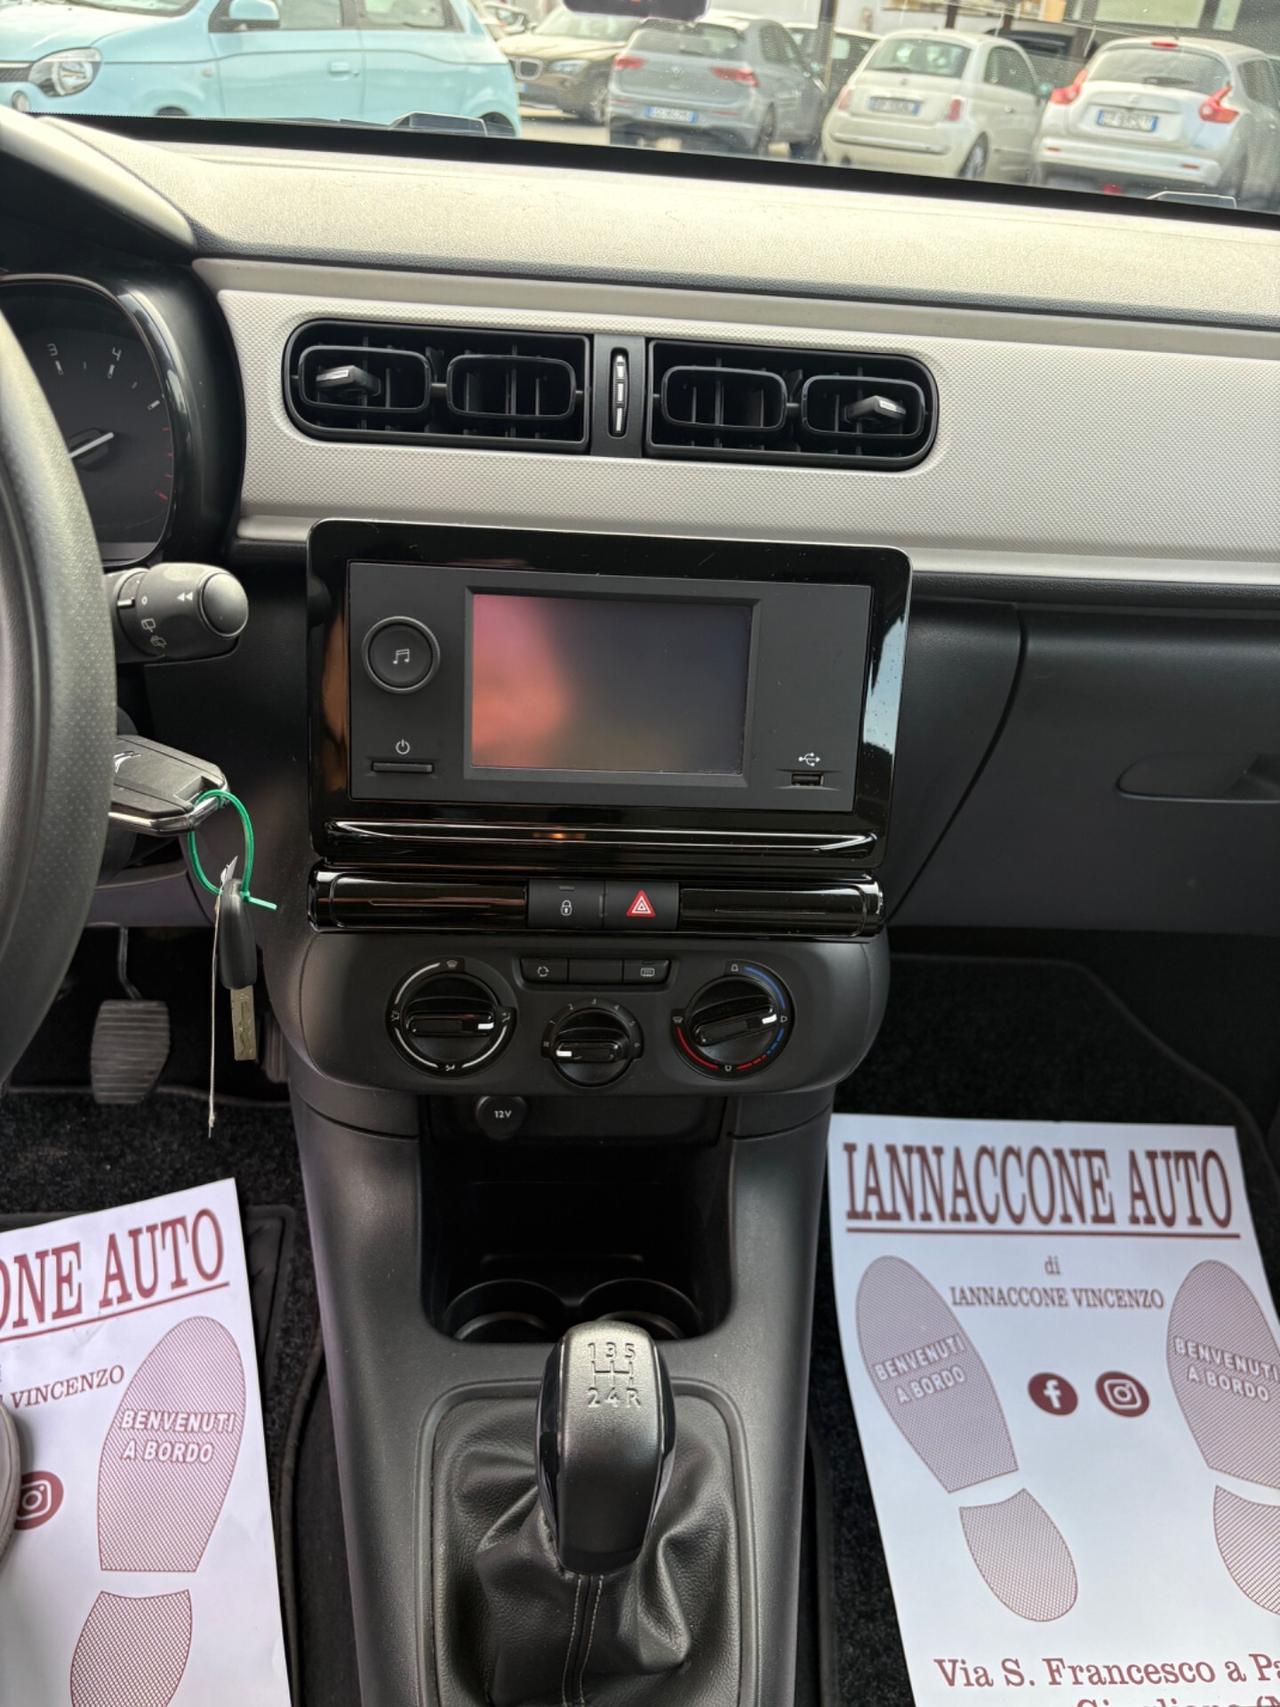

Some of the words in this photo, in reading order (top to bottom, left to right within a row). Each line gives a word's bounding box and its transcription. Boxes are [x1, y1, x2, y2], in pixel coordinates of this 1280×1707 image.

[47, 343, 58, 357] 3
[111, 347, 122, 362] 4
[494, 1110, 512, 1118] 12V
[843, 1142, 1116, 1226] IANNACCONE
[1128, 1149, 1233, 1229] AUTO
[99, 1208, 225, 1309] AUTO
[1044, 1256, 1061, 1275] di
[950, 1286, 1069, 1307] IANNACCONE
[1071, 1287, 1165, 1309] VINCENZO
[587, 1342, 597, 1361] 1
[605, 1341, 618, 1359] 3
[624, 1342, 637, 1359] 5
[873, 1333, 966, 1381] BENVENUTI
[1174, 1336, 1280, 1383] BENVENUTI
[10, 1364, 126, 1409] VINCENZO
[895, 1386, 911, 1404] A
[909, 1365, 966, 1399] BORDO
[1187, 1365, 1200, 1383] A
[1205, 1370, 1270, 1402] BORDO
[588, 1387, 601, 1408] 2
[604, 1387, 619, 1408] 4
[626, 1387, 642, 1408] R
[120, 1409, 235, 1433] BENVENUTI
[122, 1440, 137, 1462] A
[143, 1442, 215, 1464] BORDO
[933, 1658, 994, 1687] Via
[1000, 1658, 1036, 1686] S.
[1041, 1656, 1217, 1686] Francesco
[1224, 1661, 1247, 1682] a
